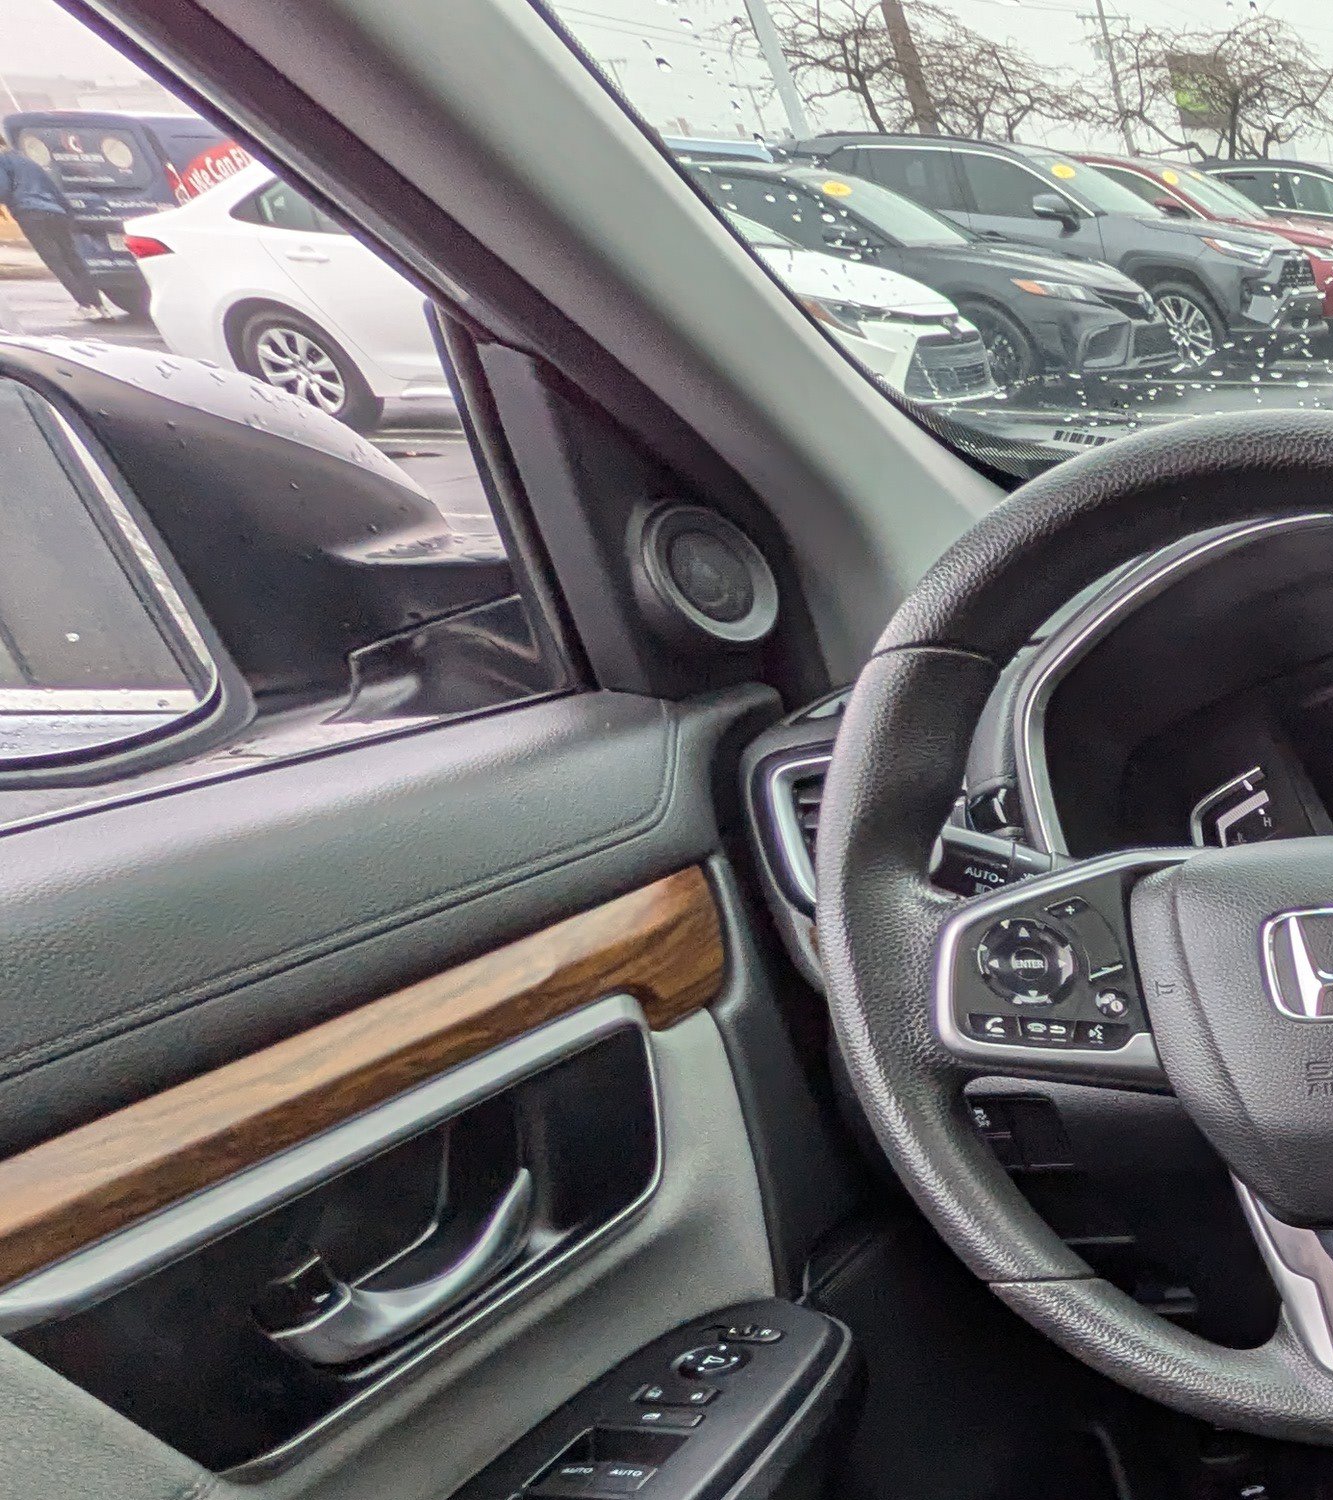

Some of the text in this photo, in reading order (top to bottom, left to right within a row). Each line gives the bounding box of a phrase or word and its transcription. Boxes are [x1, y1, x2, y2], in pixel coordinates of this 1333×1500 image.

[1262, 816, 1273, 828] H
[963, 866, 1000, 883] AUTO
[1015, 958, 1045, 969] ENTER
[561, 1466, 594, 1475] AUTO
[609, 1467, 643, 1478] AUTO
